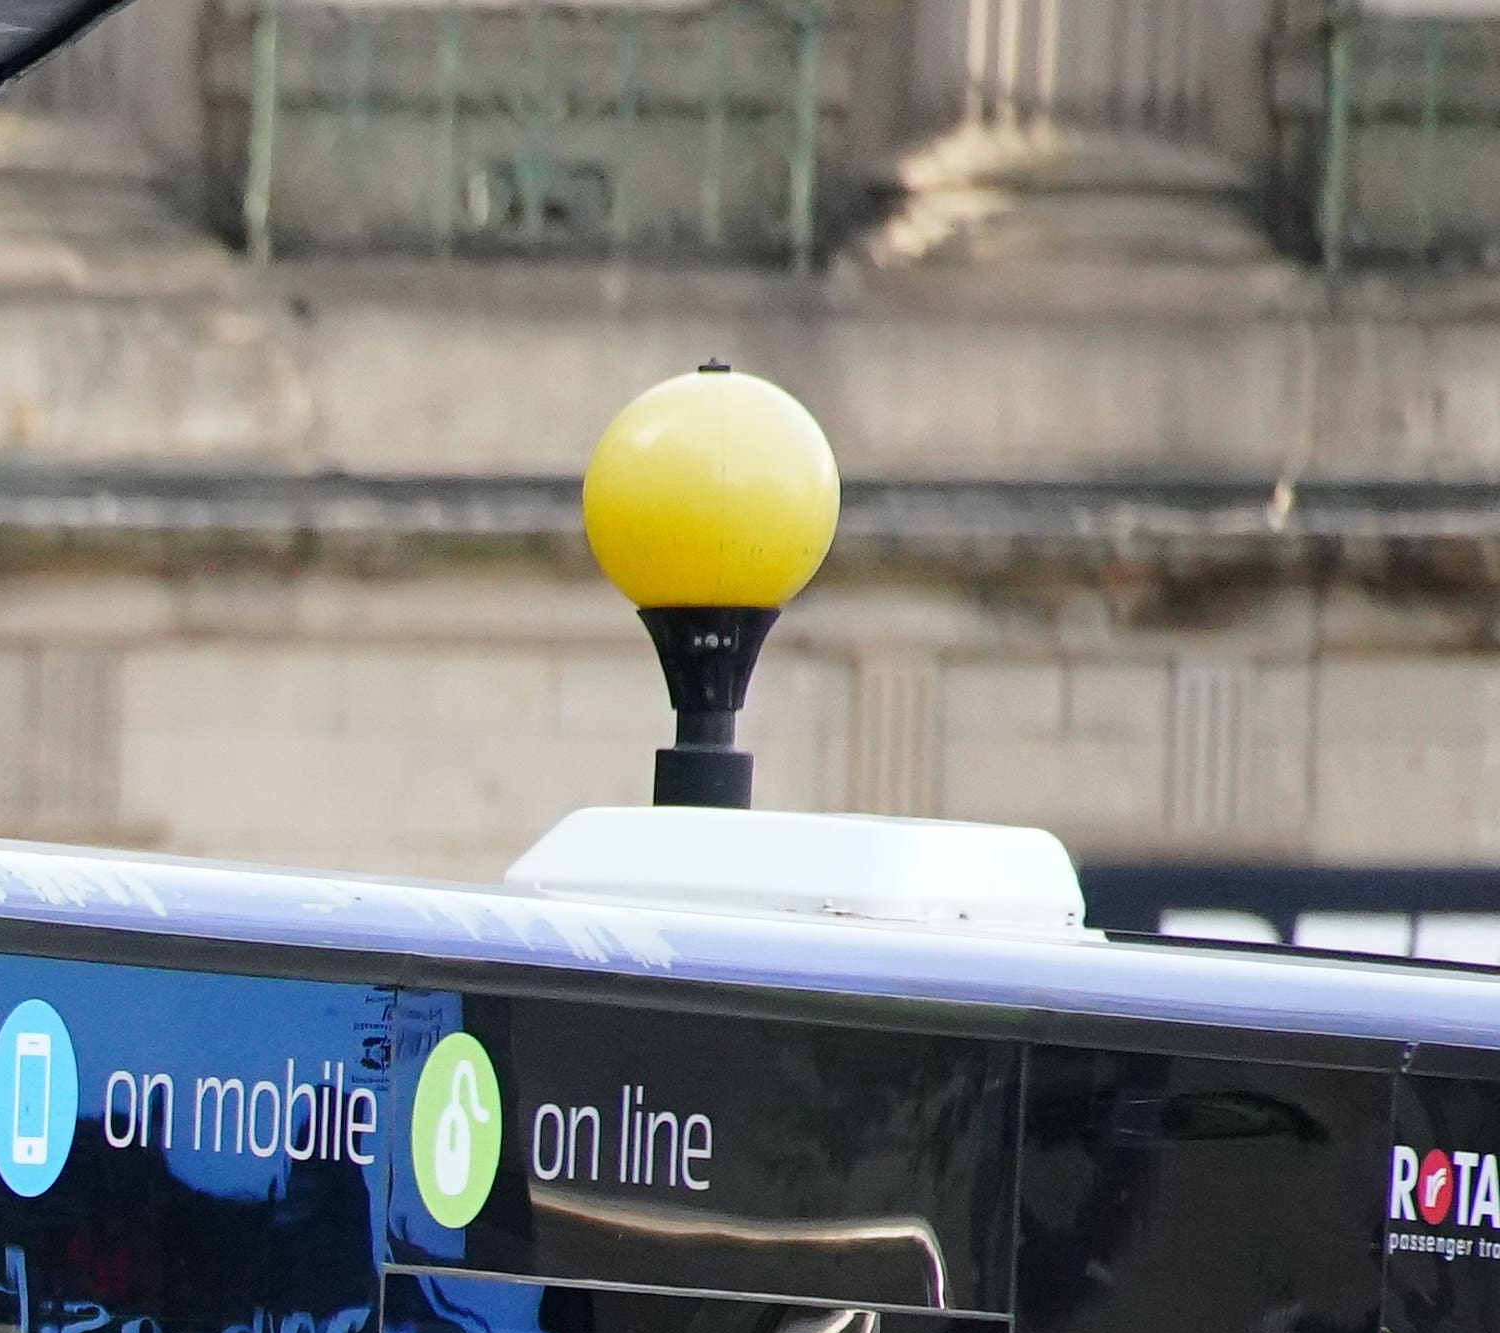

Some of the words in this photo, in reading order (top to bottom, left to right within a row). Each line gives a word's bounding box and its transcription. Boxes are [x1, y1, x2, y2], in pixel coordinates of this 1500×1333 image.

[103, 1070, 176, 1151] on
[192, 1058, 379, 1166] mobile
[531, 1101, 600, 1183] on
[618, 1083, 714, 1192] line
[1388, 1231, 1475, 1262] passenger
